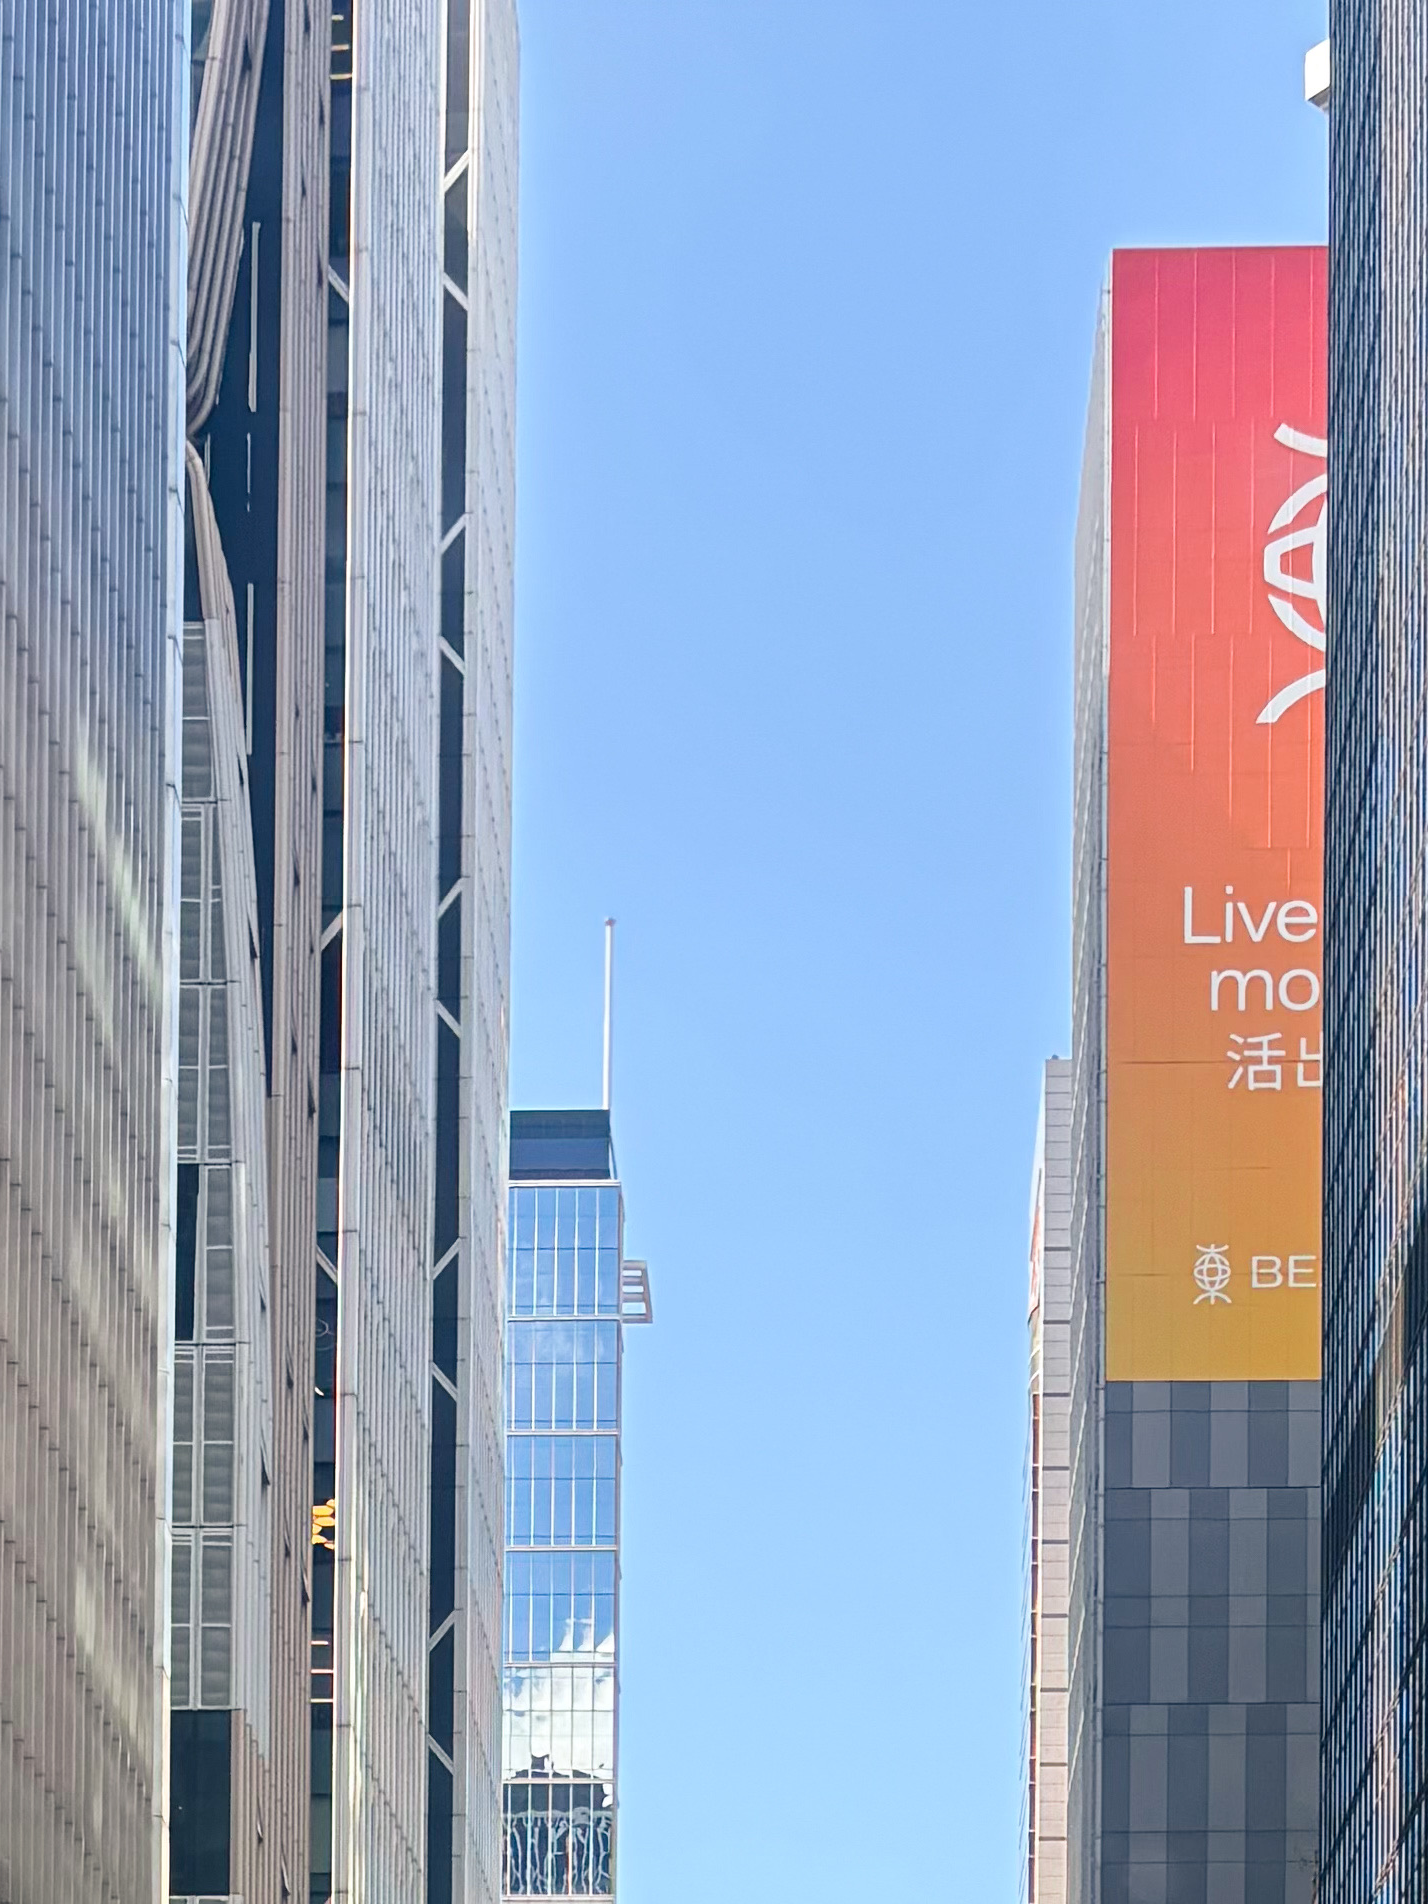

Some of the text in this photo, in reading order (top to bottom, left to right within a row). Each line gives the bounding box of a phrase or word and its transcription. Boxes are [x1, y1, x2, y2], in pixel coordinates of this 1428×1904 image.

[1184, 886, 1318, 944] Live
[1211, 969, 1320, 1011] mo
[1252, 1255, 1320, 1288] BE
